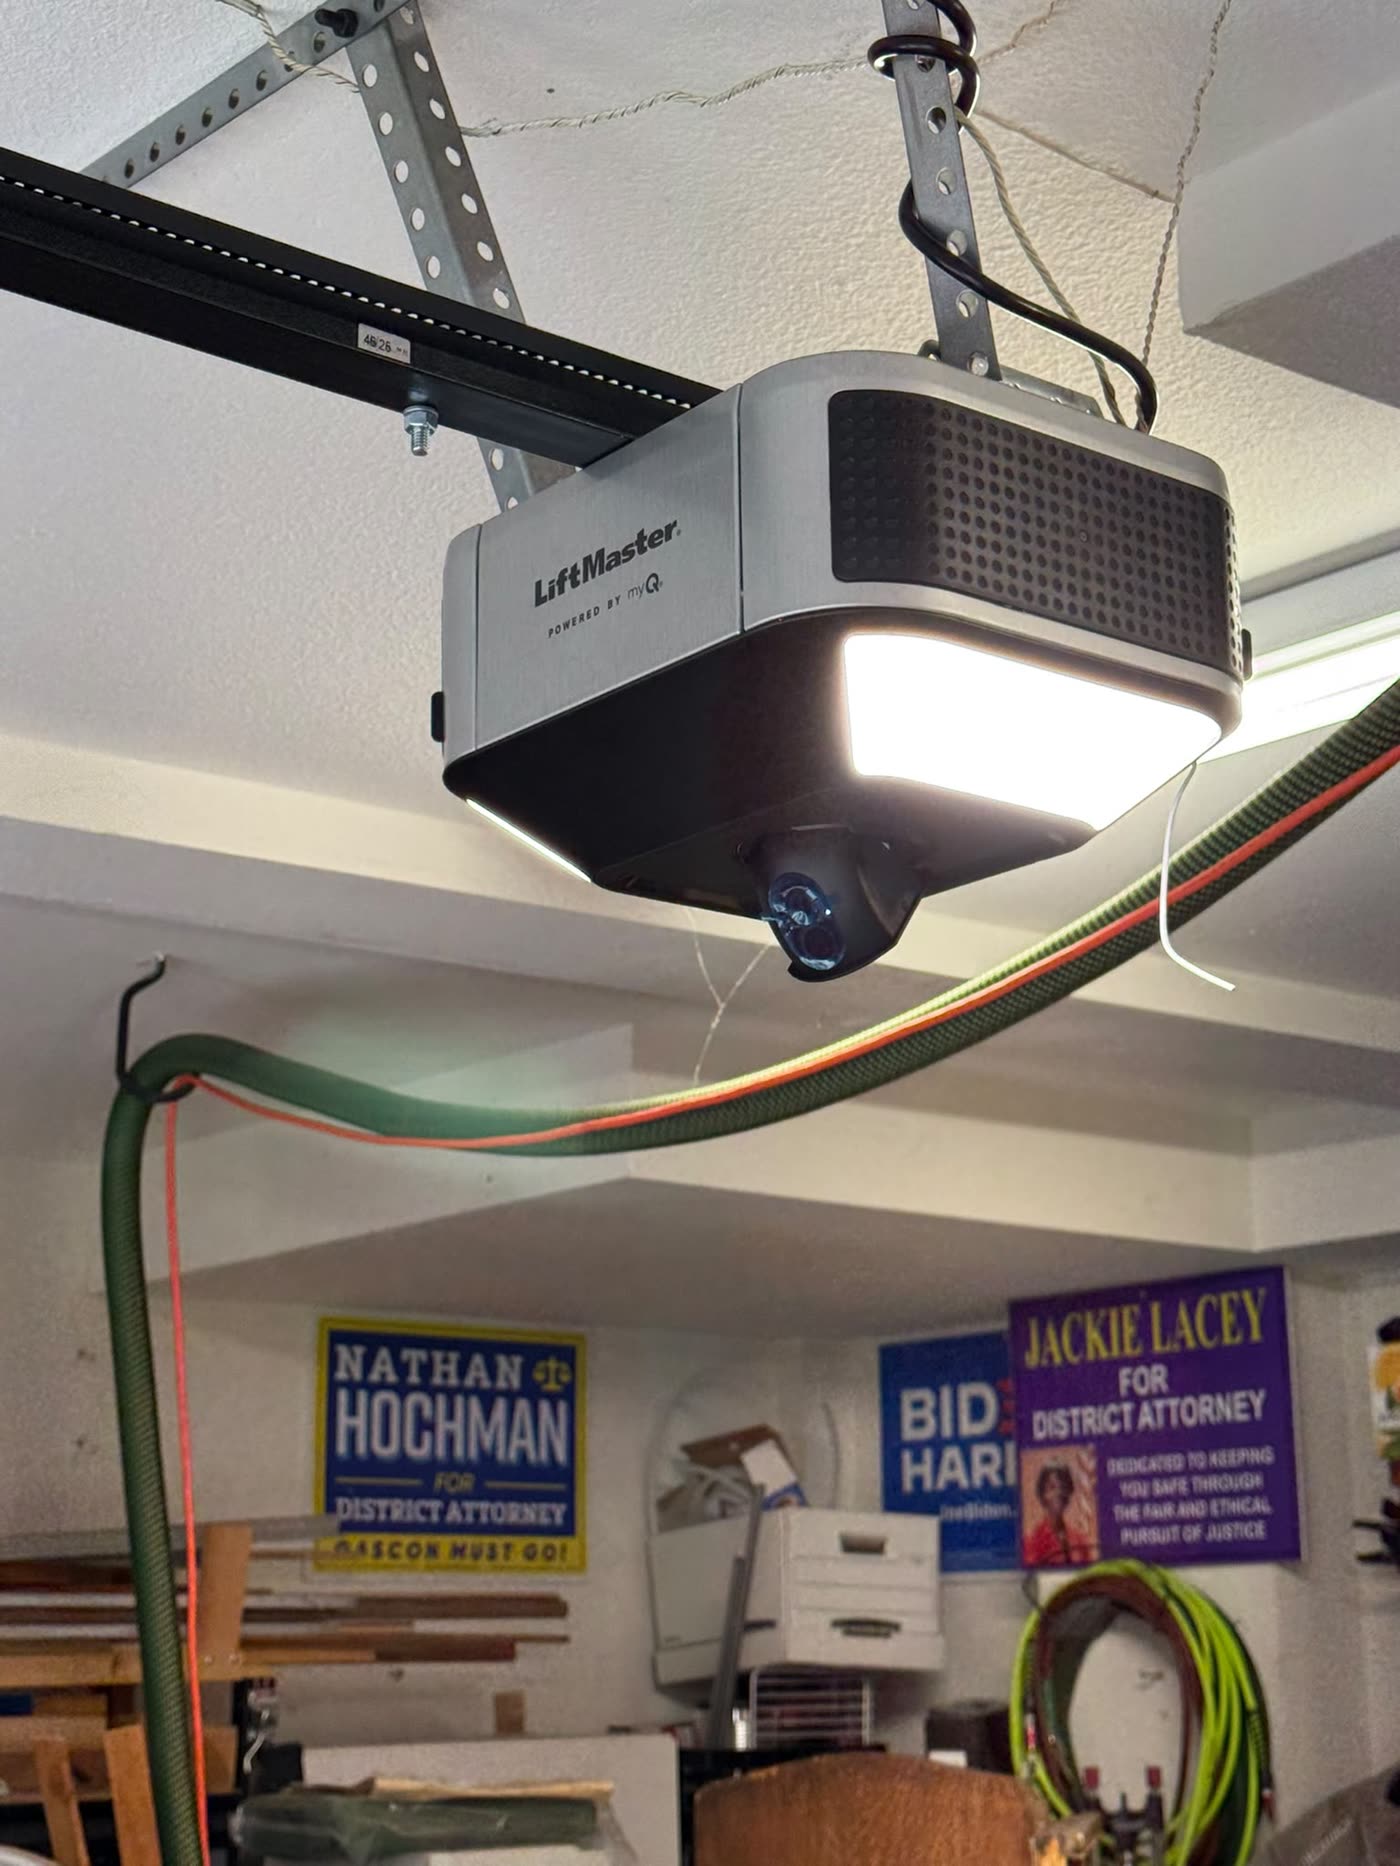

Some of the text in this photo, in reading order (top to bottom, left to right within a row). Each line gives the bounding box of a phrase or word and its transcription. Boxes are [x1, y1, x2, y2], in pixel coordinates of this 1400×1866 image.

[534, 520, 678, 608] LiftMaster
[548, 573, 660, 638] POWERED BY myQ
[1025, 1287, 1267, 1369] JACKIE LACEY
[335, 1344, 524, 1391] NATHAN
[1118, 1363, 1169, 1398] FOR
[335, 1387, 569, 1465] HOCHMAN
[1032, 1389, 1267, 1441] DISTRICT ATTORNEY
[1106, 1445, 1275, 1478] DEDICATED TO KEEPING
[432, 1472, 476, 1494] FOR
[1120, 1471, 1264, 1498] YOU SAFE THROUGH
[335, 1497, 568, 1526] DISTRICT ATTORNEY
[1114, 1496, 1273, 1522] THE FAIR AND ETHICAL
[1120, 1519, 1267, 1545] PURSUIT OF JUSTICE
[452, 1543, 512, 1561] MUST
[523, 1543, 567, 1562] GO!
